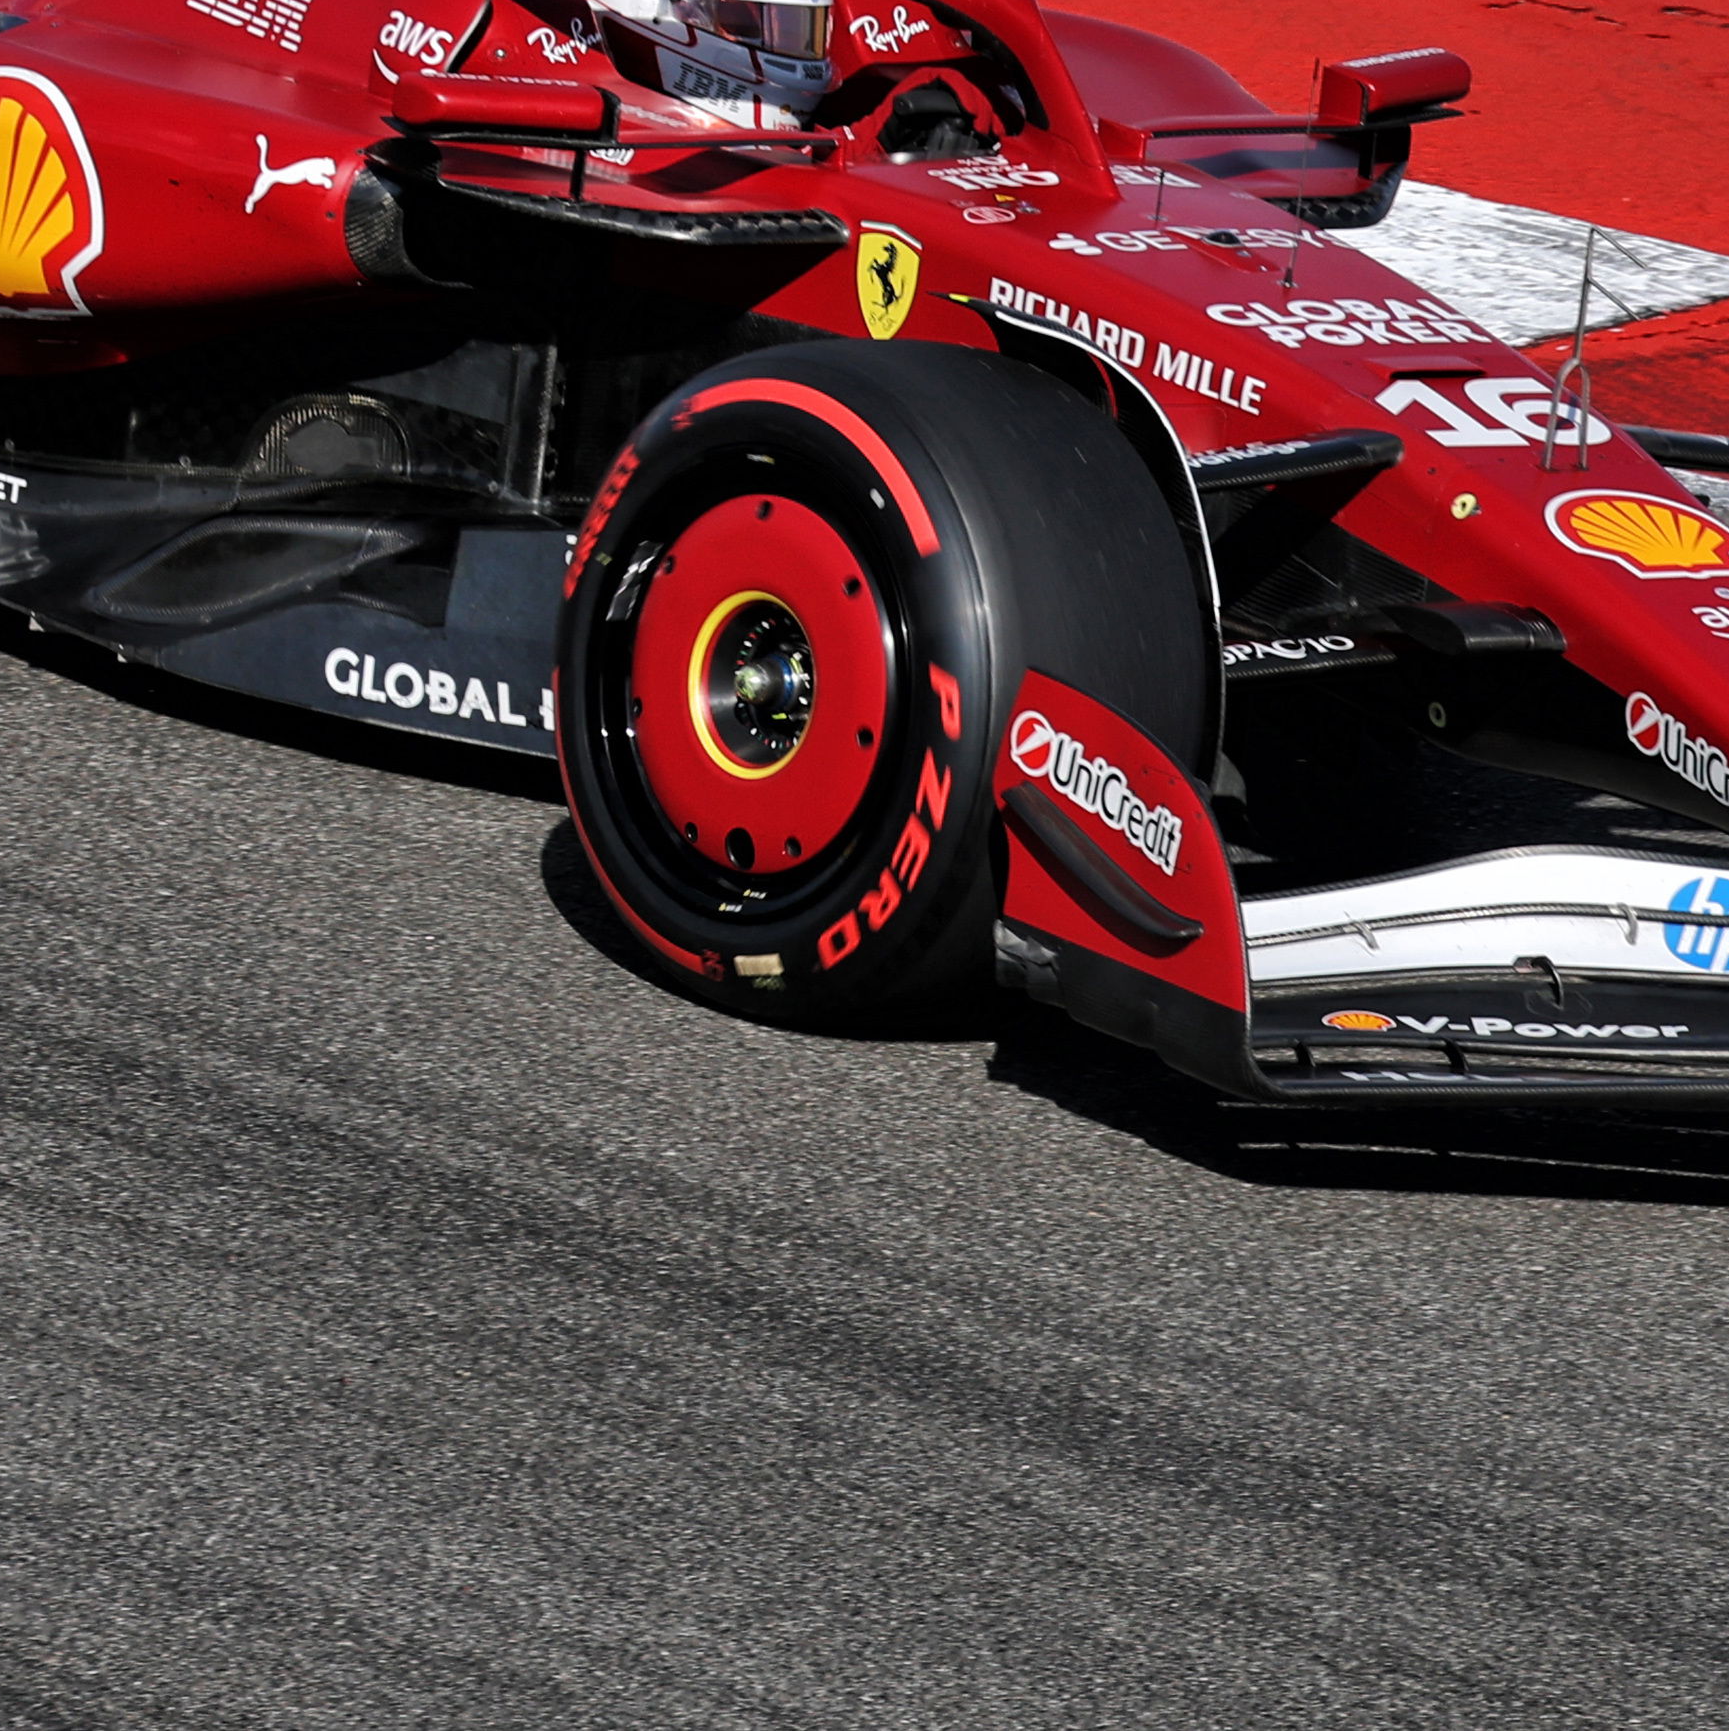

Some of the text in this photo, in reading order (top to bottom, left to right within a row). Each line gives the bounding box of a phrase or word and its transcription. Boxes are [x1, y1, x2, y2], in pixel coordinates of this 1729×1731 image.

[379, 9, 454, 63] aws
[1206, 298, 1469, 327] GLOBAL
[1259, 320, 1493, 349] POKER
[1153, 342, 1266, 417] MILLE
[1375, 377, 1611, 447] 16
[325, 647, 527, 727] GLOBAL
[817, 661, 962, 970] P ZERO
[1052, 742, 1183, 877] UniCredit
[1395, 1015, 1690, 1040] V-Power
